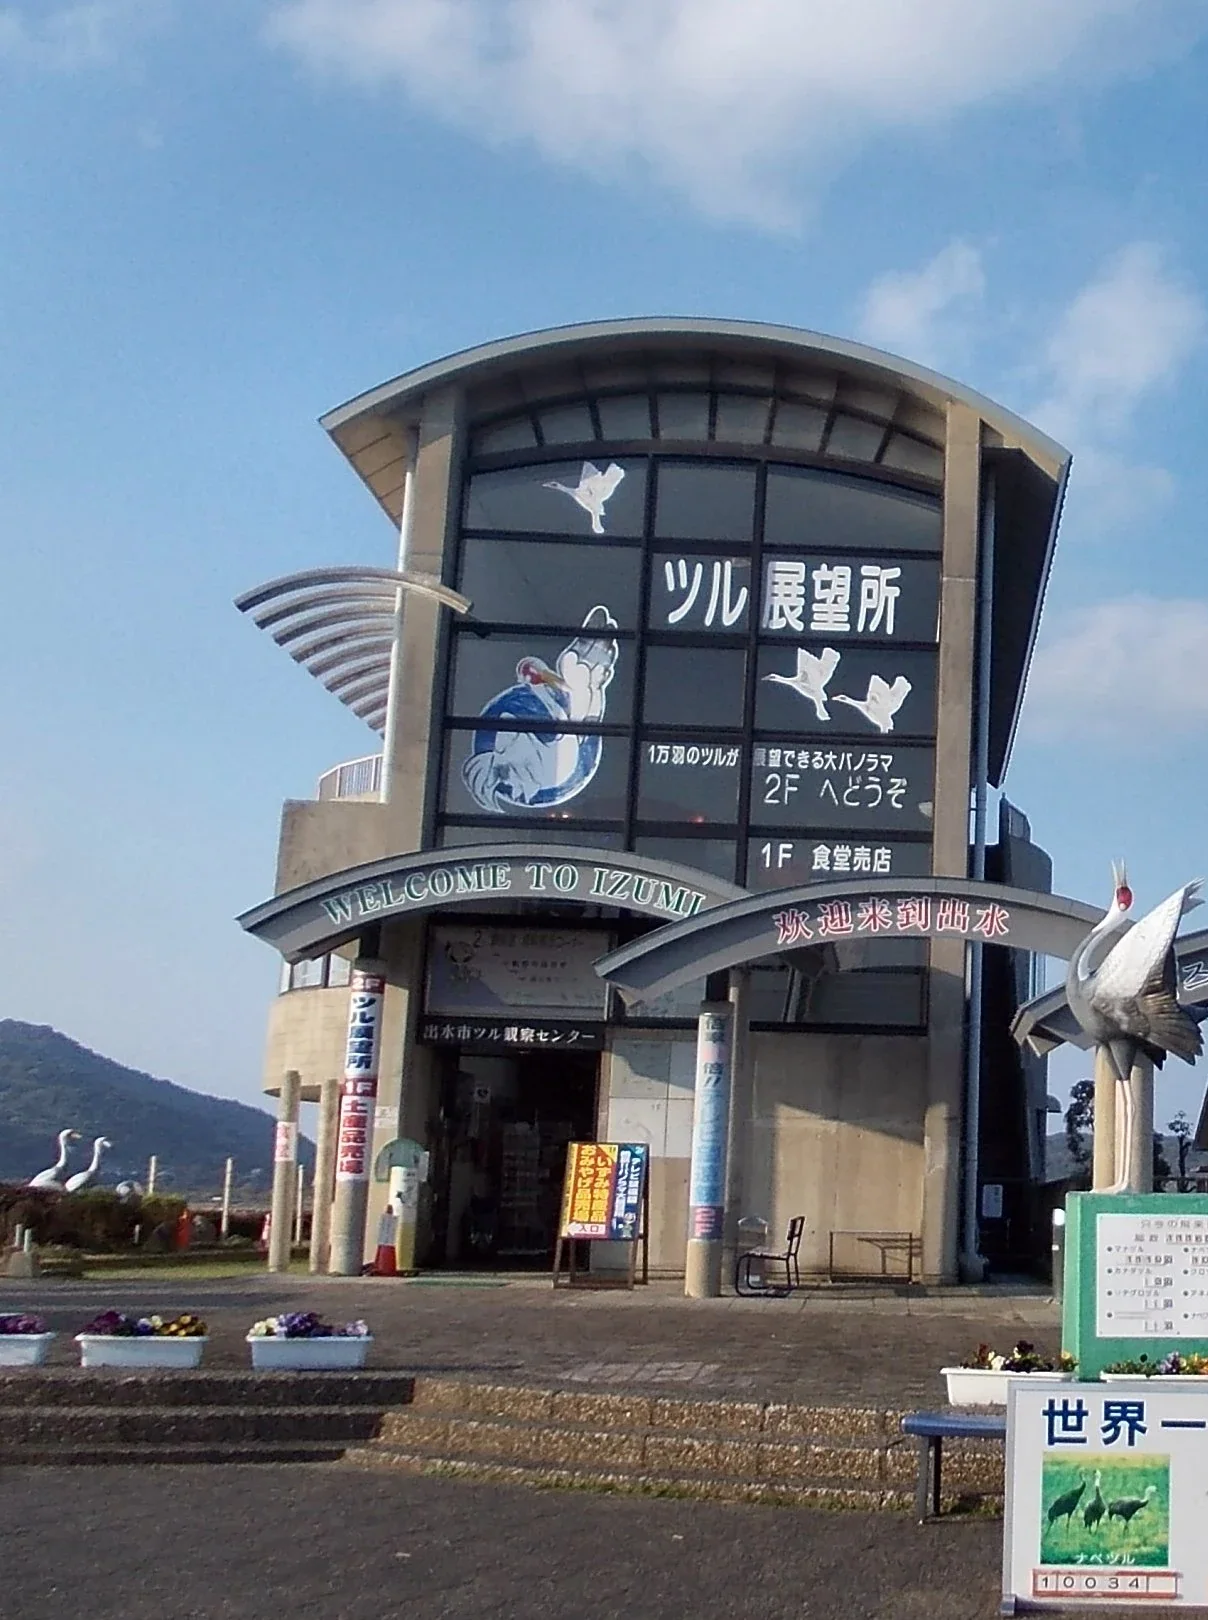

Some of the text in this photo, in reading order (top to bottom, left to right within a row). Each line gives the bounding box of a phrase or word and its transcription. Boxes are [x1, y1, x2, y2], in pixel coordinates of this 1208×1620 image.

[664, 558, 901, 635] ツル 展望所
[764, 773, 908, 809] 2F へどうぞ
[761, 842, 893, 873] 1F 食堂売店
[320, 861, 707, 926] WELCOME TO IZUMI
[772, 896, 1011, 945] 欢迎来到出水
[352, 977, 381, 991] 2F
[344, 1080, 373, 1094] 1F
[579, 1224, 599, 1232] 入口
[1041, 1575, 1140, 1590] 10034
